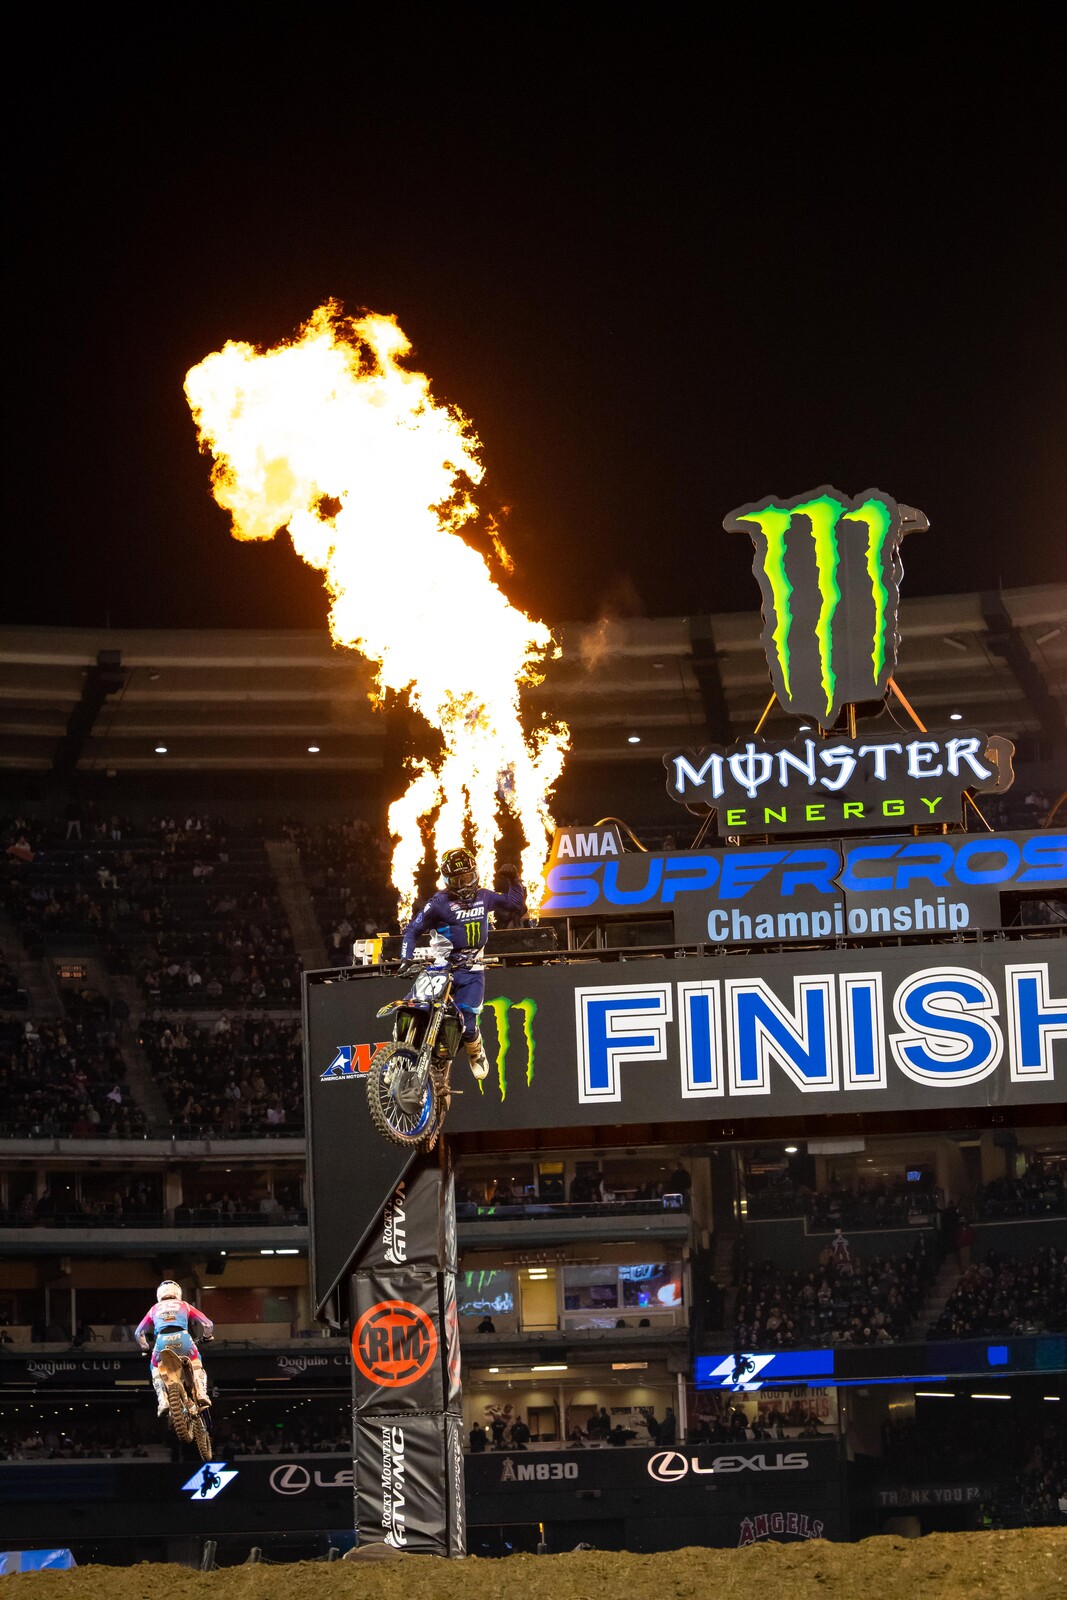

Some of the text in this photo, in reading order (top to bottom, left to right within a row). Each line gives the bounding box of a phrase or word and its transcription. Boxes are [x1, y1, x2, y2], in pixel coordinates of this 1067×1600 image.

[673, 738, 991, 798] MONSTER
[727, 797, 942, 826] ENERGY
[557, 832, 618, 858] AMA
[455, 906, 485, 919] THOR
[707, 897, 969, 941] Championship
[383, 1209, 393, 1246] ROCKY
[369, 1325, 421, 1362] RM
[82, 1360, 120, 1370] CLUB
[334, 1356, 351, 1366] CL
[382, 1426, 392, 1529] ROCKY MOUNTAIN
[691, 1452, 809, 1474] LEXUS
[934, 1488, 962, 1502] YOU
[738, 1512, 824, 1548] ANGELS
